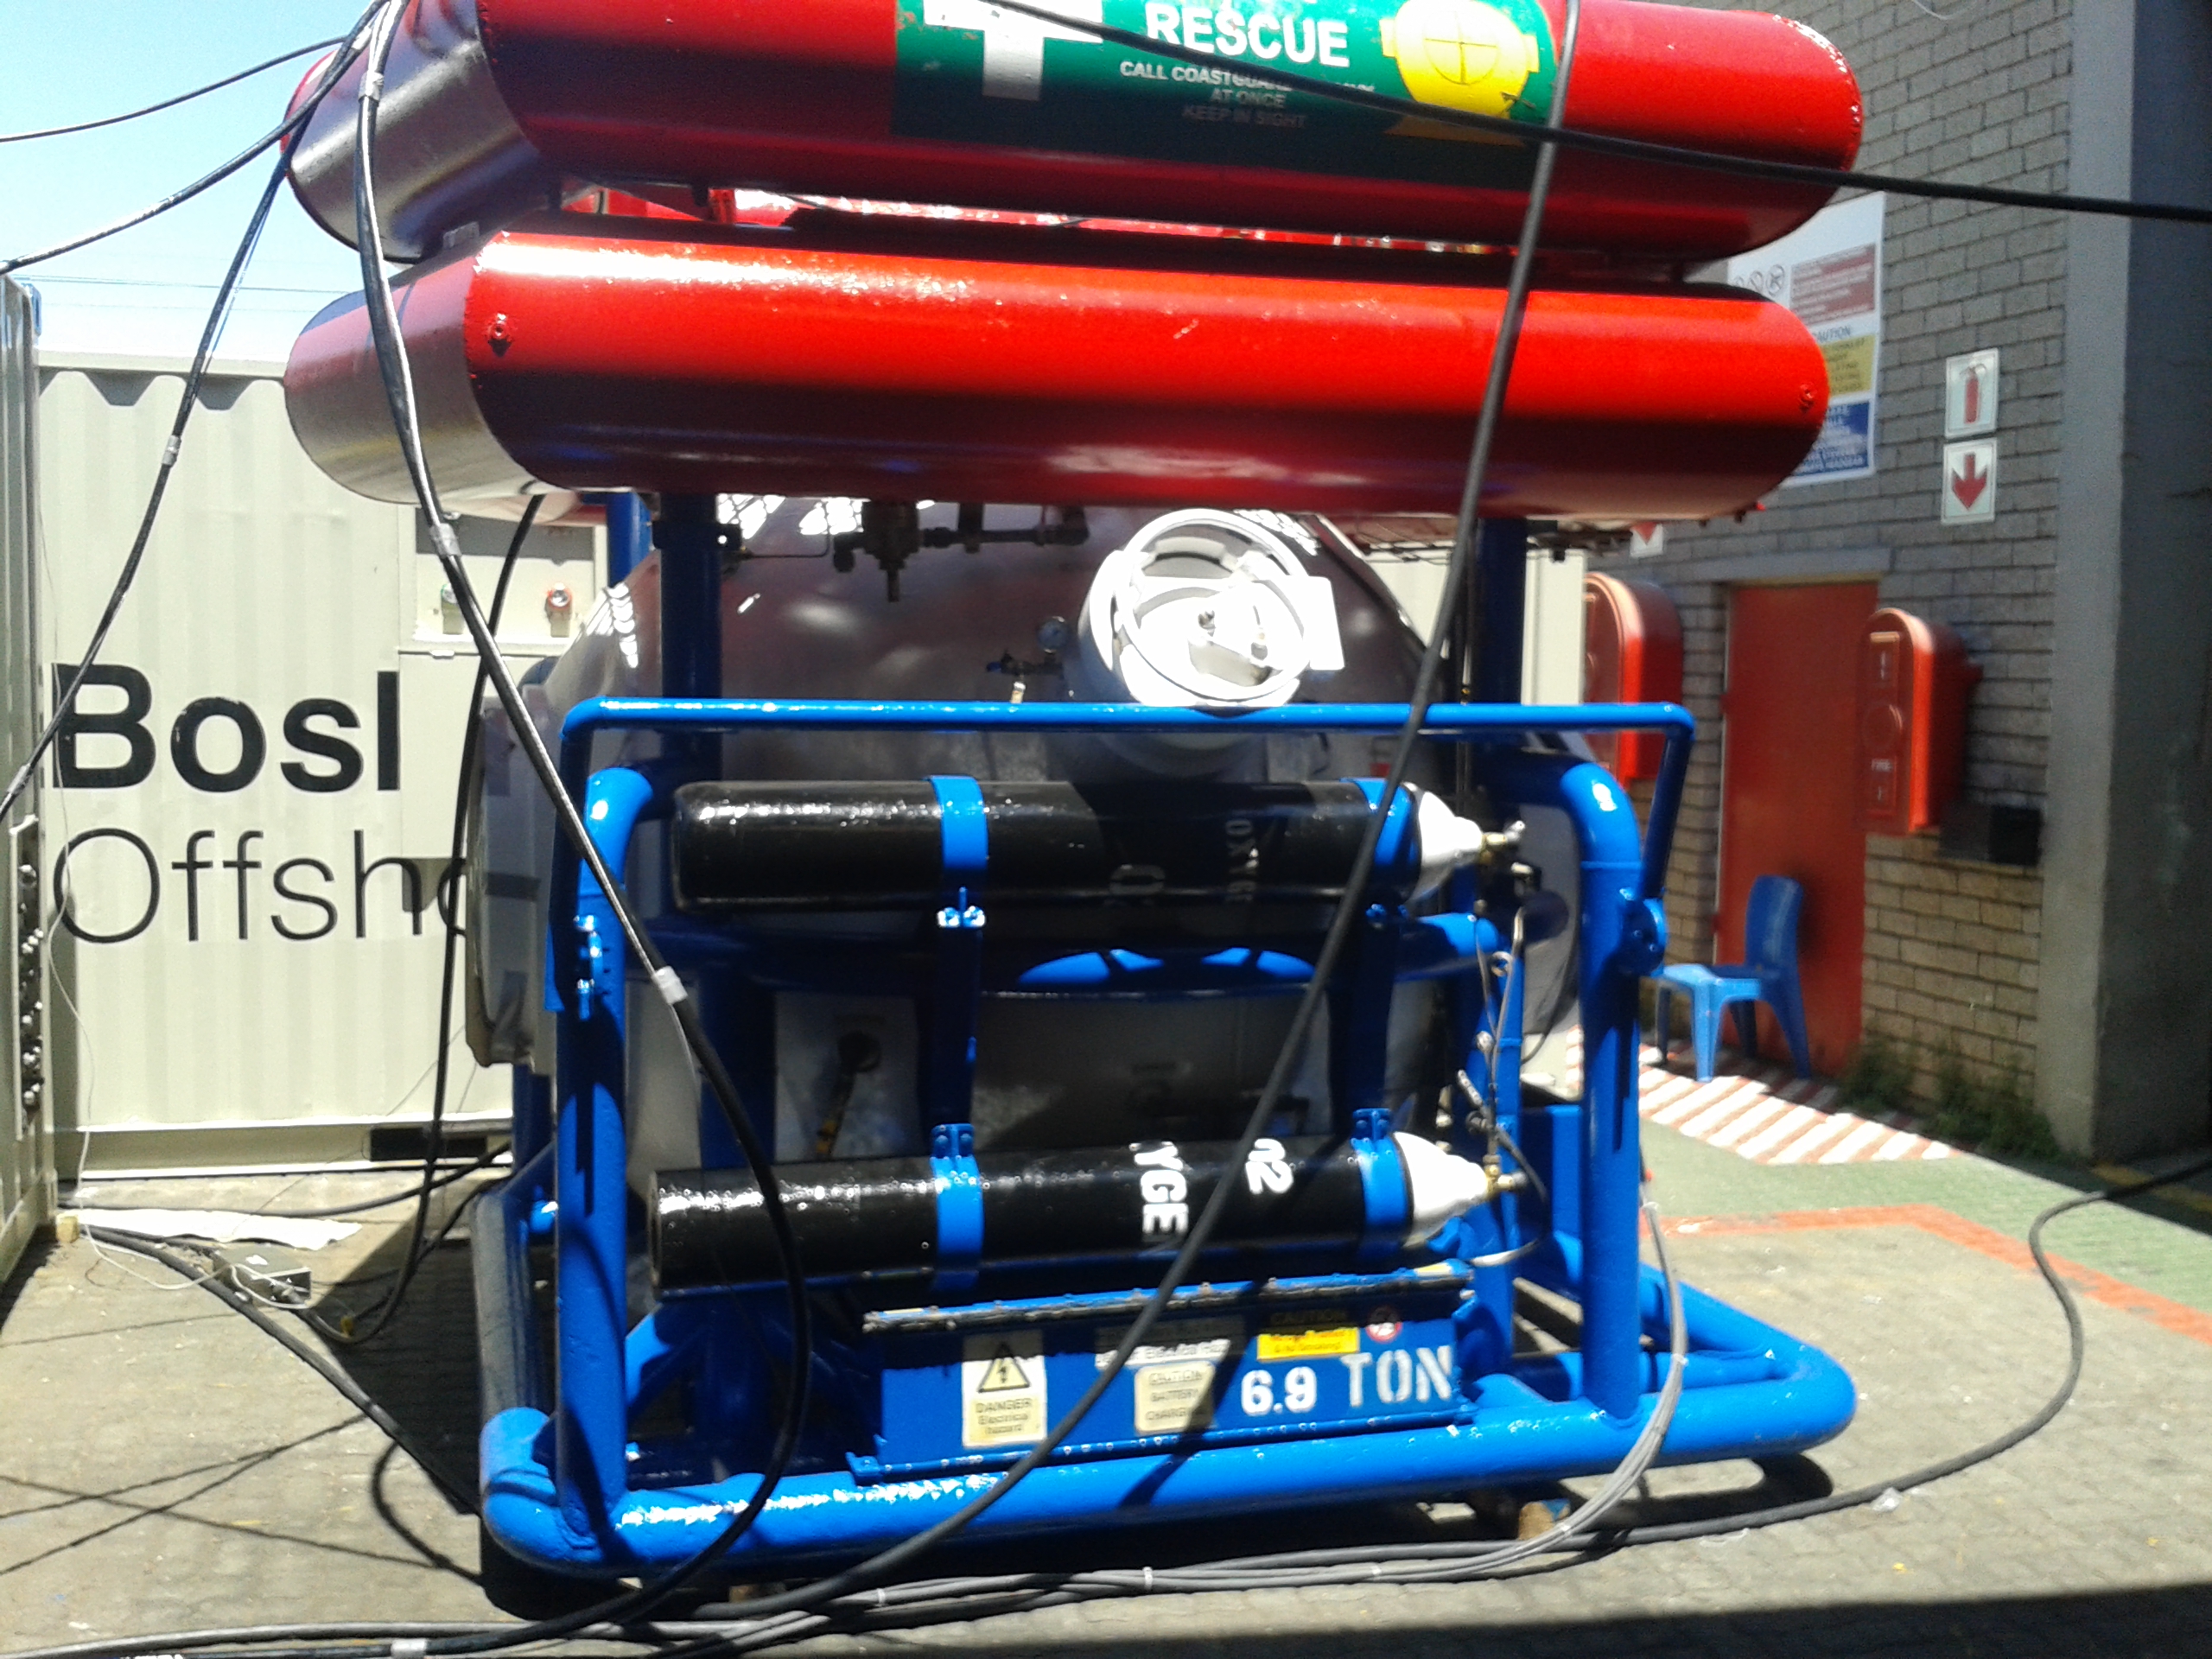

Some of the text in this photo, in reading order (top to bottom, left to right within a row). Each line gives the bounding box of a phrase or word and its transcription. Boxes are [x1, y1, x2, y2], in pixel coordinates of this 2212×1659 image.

[1145, 3, 1350, 67] RESCUE
[1120, 60, 1293, 92] CALL COASTGU
[1211, 88, 1287, 109] AT ONCE
[1241, 1344, 1453, 1414] 6.9 TON
[975, 1397, 1033, 1414] DANGER
